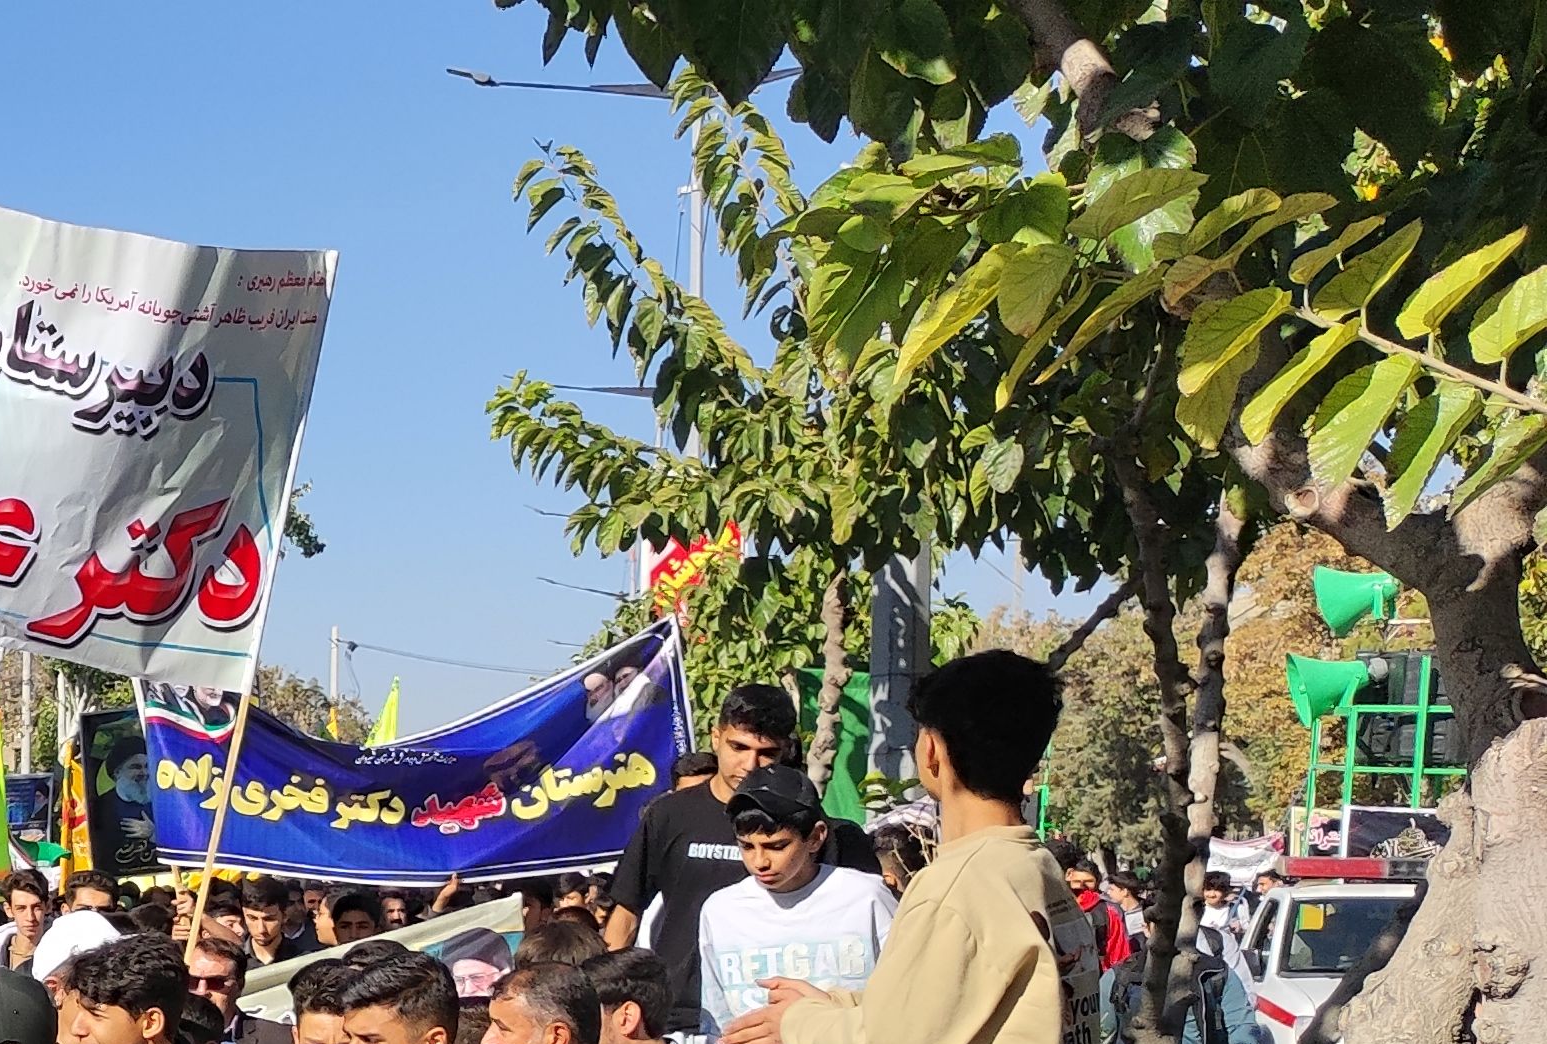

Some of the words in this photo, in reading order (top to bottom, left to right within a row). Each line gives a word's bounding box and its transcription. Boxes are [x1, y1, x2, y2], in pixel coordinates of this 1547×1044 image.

[26, 496, 264, 646] دکتر
[156, 754, 225, 810] زاده
[230, 775, 330, 822] فخری
[330, 789, 406, 829] دکتر
[411, 782, 507, 834] شهید
[511, 752, 657, 820] هنرستان
